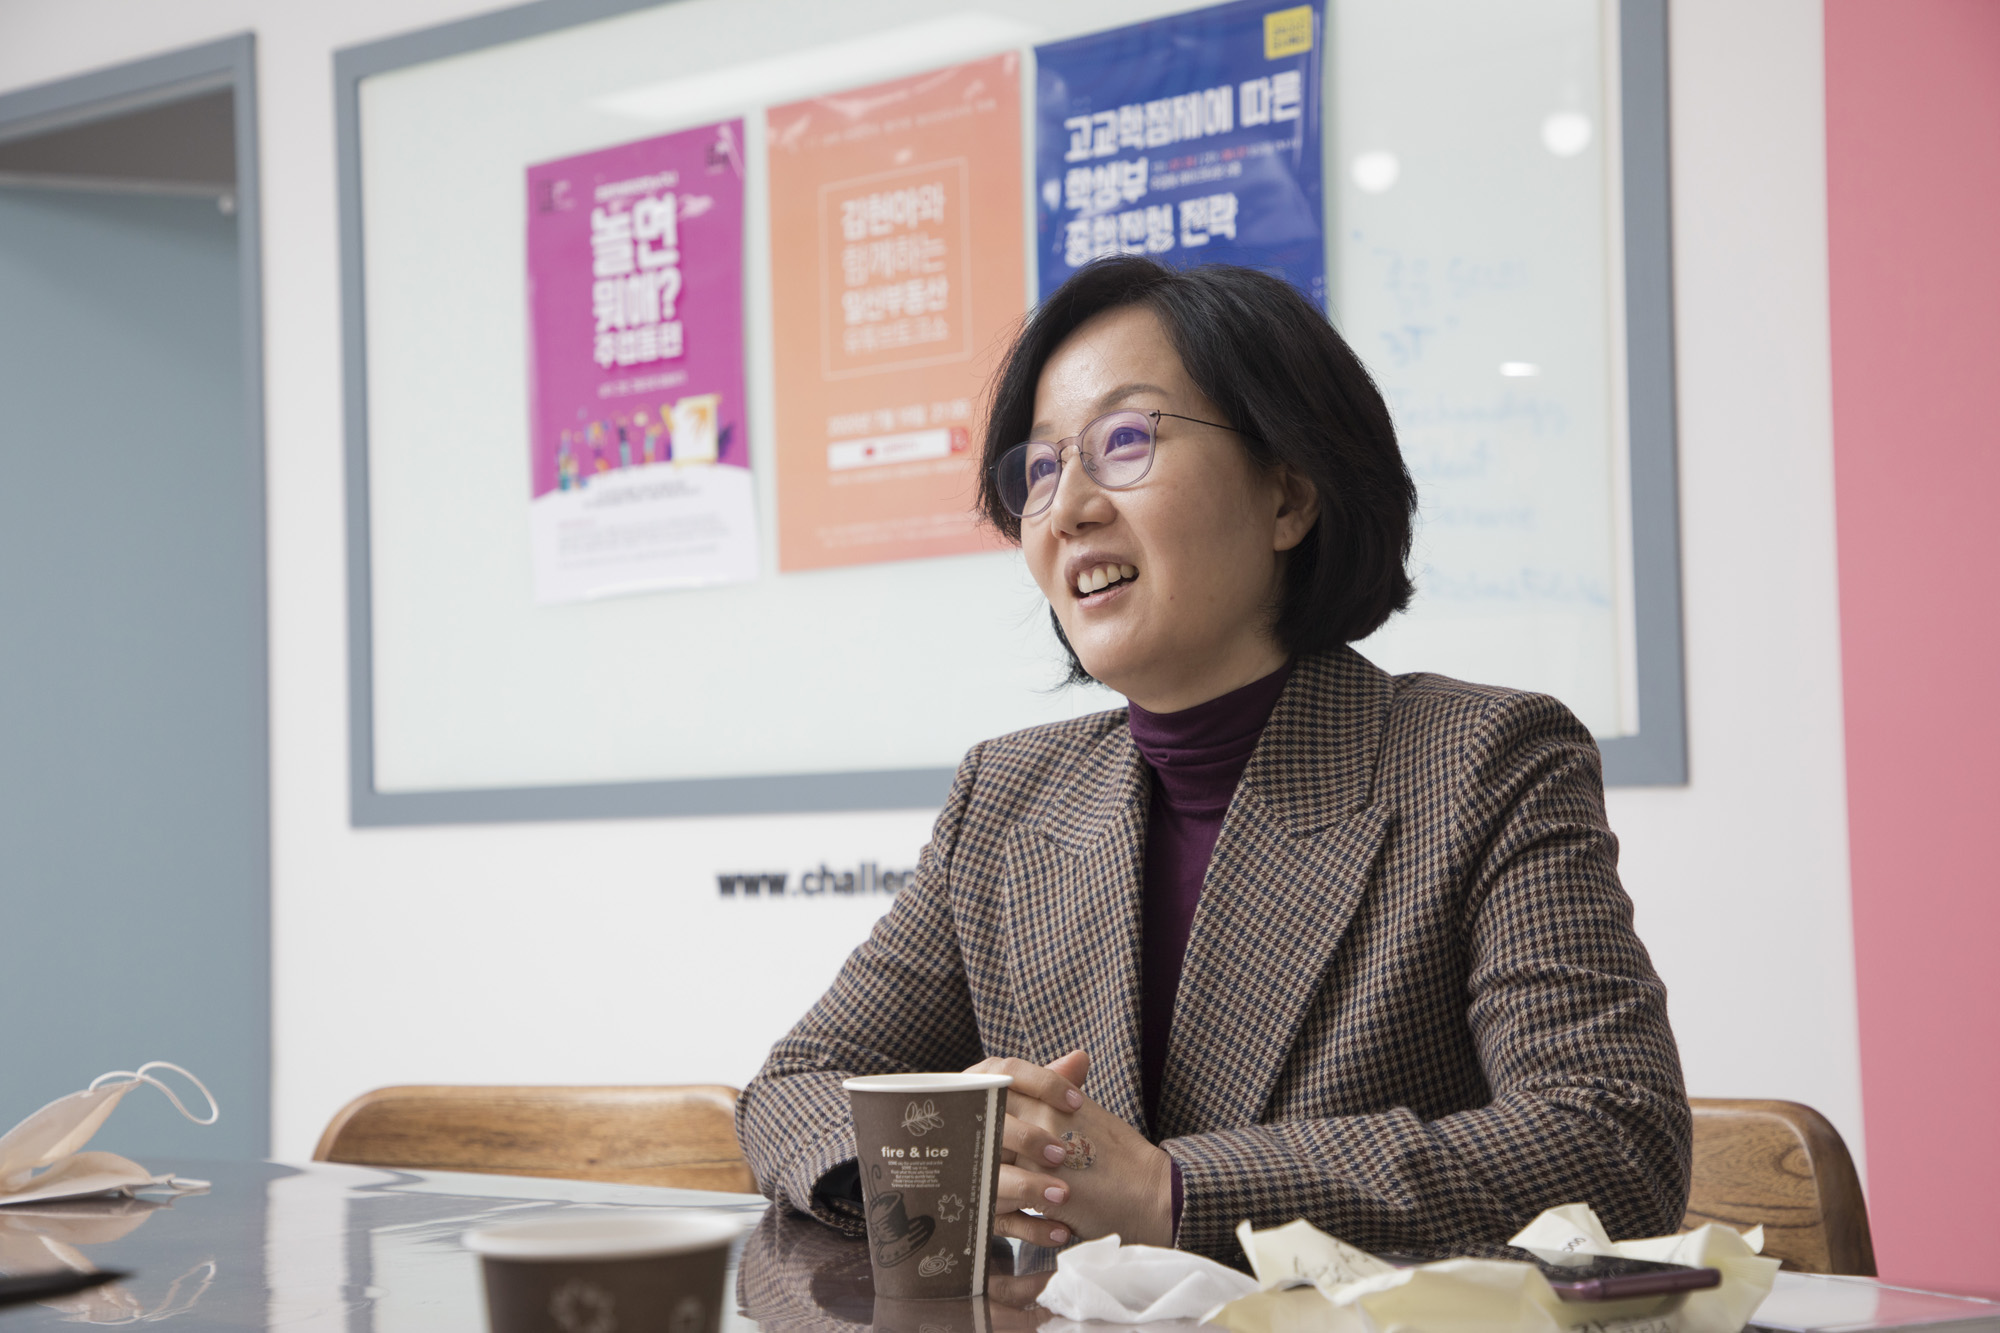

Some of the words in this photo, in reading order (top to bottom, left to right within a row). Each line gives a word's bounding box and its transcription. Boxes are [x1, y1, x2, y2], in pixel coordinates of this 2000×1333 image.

[1064, 85, 1234, 162] 고교학점제에
[1239, 70, 1302, 127] 따른
[841, 181, 946, 241] 김현아와
[1064, 157, 1149, 210] 학생부
[1064, 203, 1175, 267] 종합전형
[1179, 192, 1238, 248] 전략
[842, 231, 948, 288] 함께하는
[842, 274, 949, 326] 일산부동산
[881, 1146, 905, 1158] fire
[909, 1146, 920, 1158] &
[925, 1146, 949, 1158] ice
